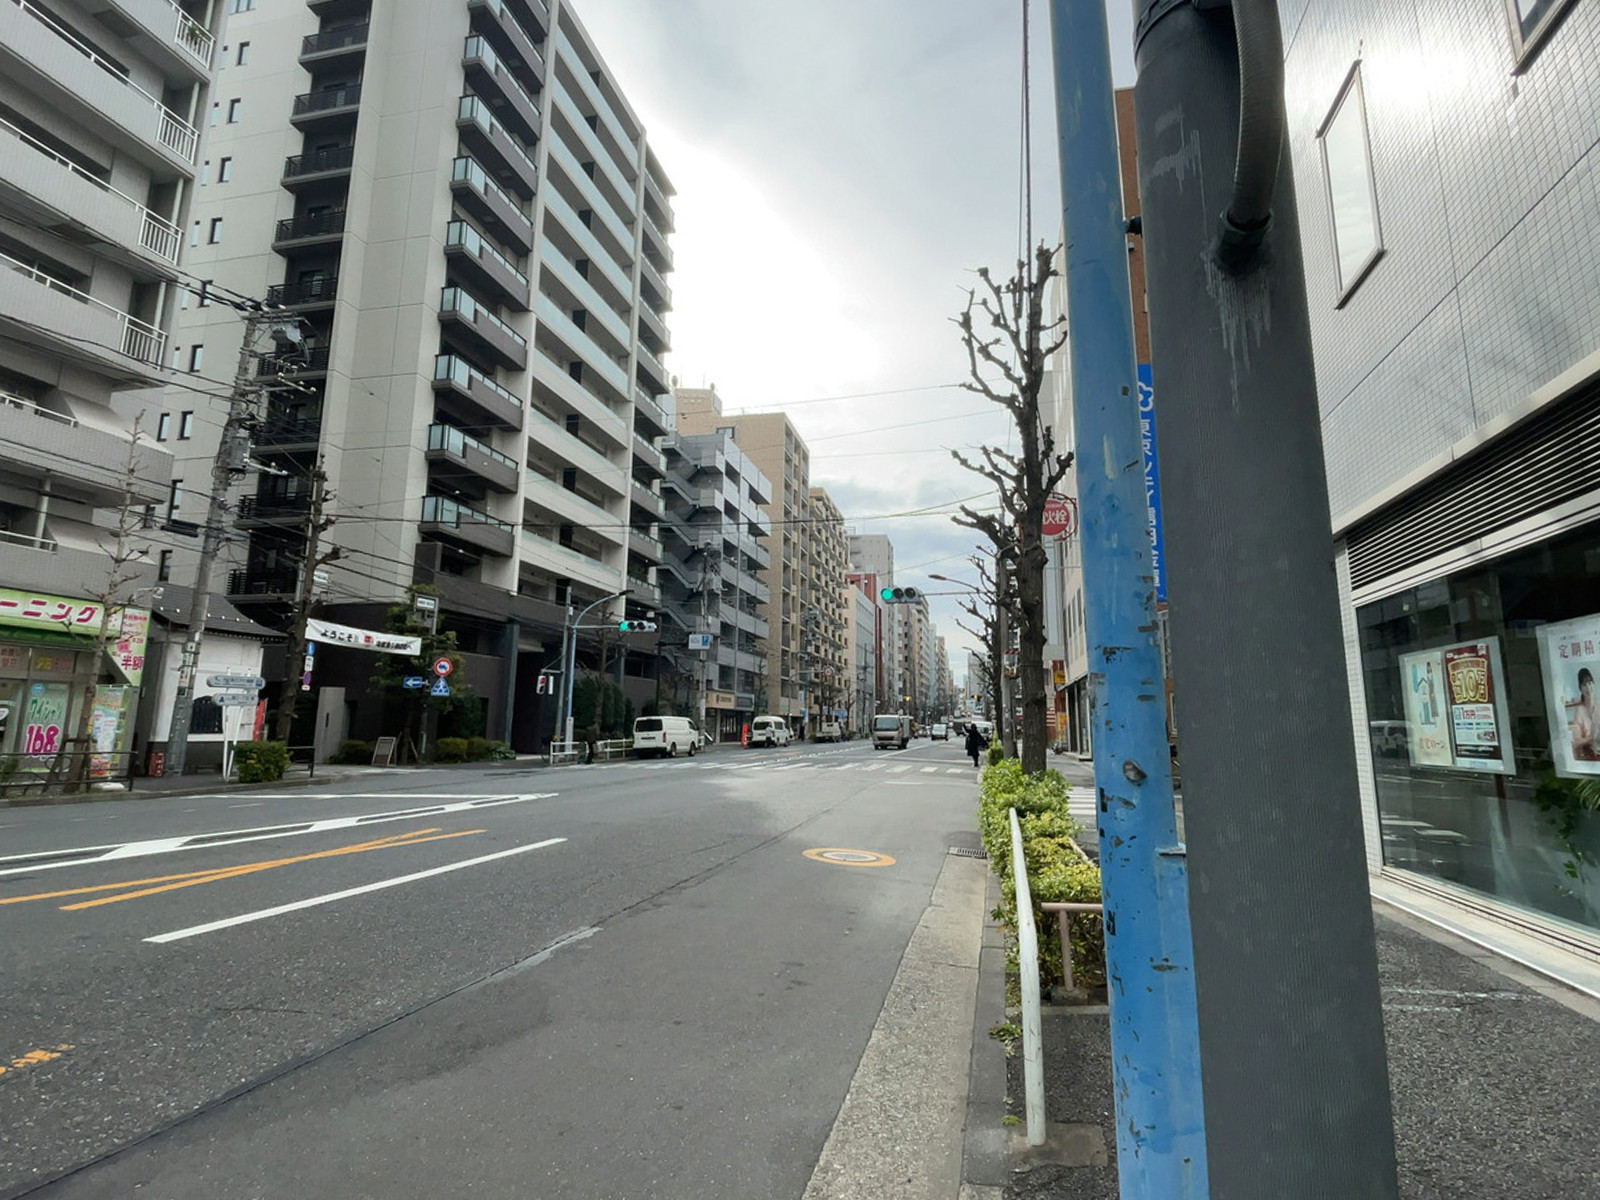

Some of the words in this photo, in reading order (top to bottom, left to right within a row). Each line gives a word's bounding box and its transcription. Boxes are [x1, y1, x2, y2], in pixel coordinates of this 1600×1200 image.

[1042, 510, 1067, 525] 火栓
[320, 629, 353, 643] ようこそ
[1558, 640, 1600, 659] 定期積
[121, 655, 144, 671] 半額
